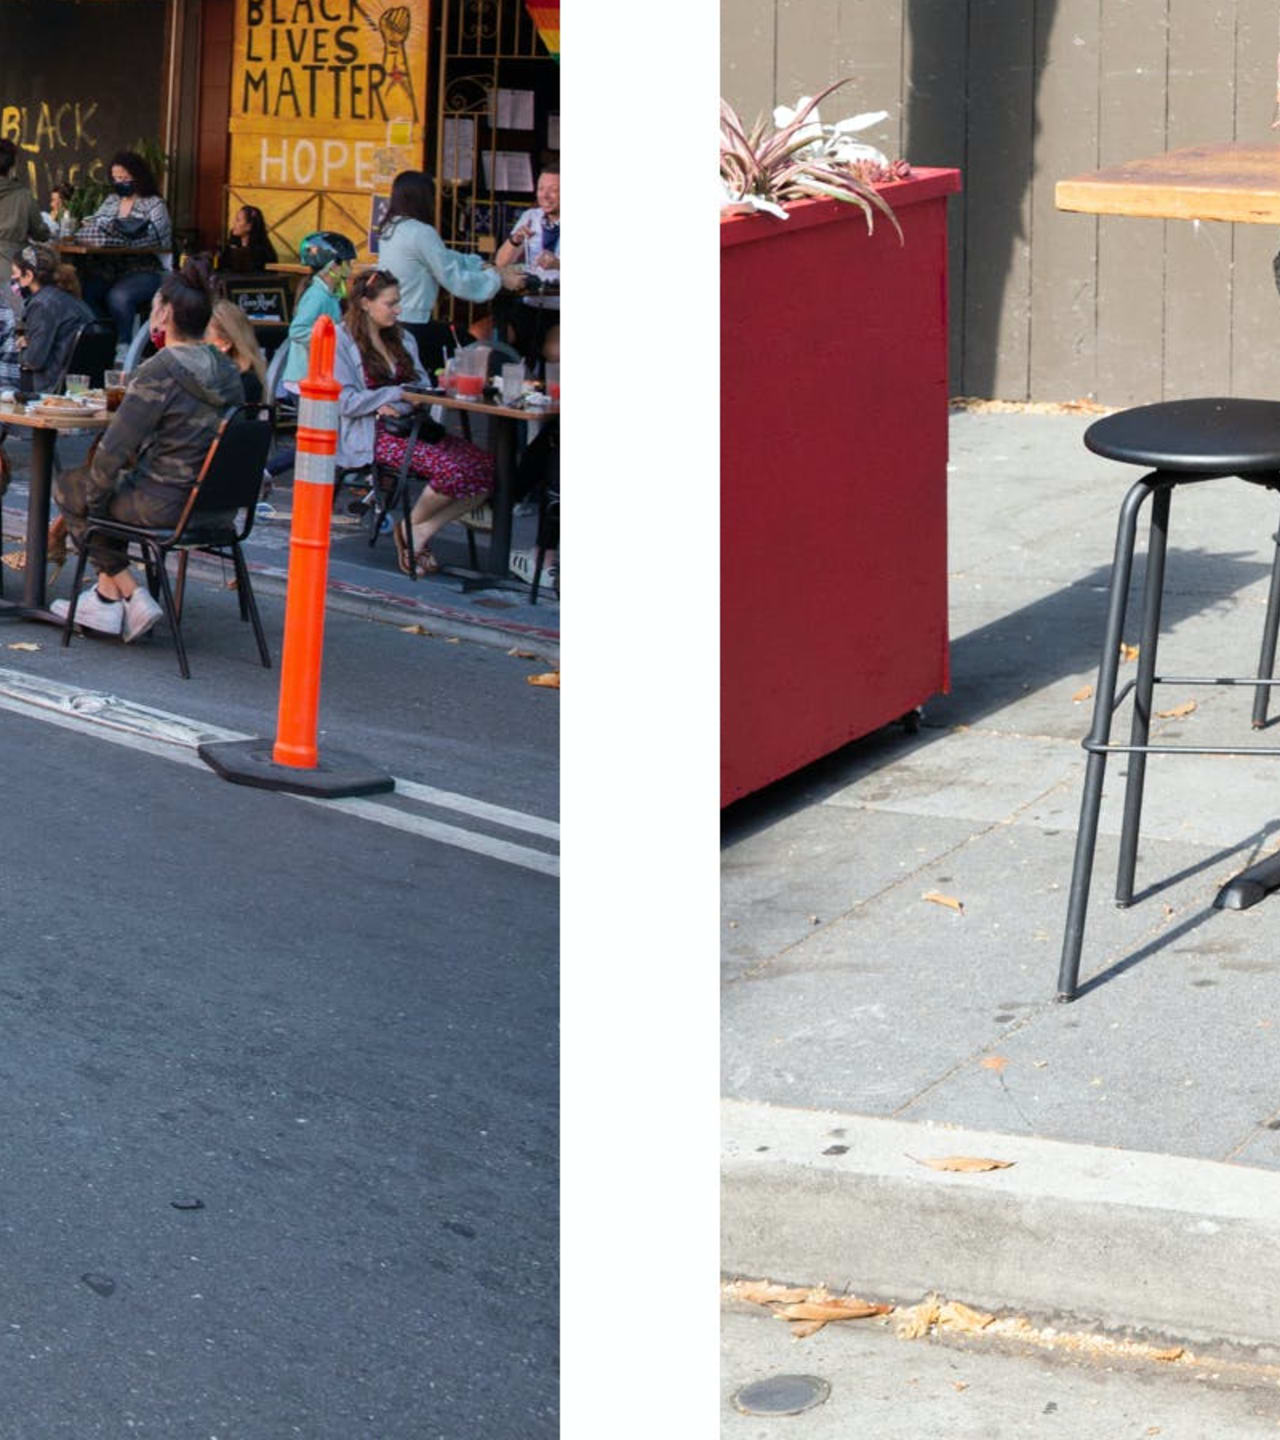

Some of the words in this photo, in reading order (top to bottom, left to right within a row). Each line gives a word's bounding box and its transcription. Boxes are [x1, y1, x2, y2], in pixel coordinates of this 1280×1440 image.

[246, 26, 360, 65] LIVES
[243, 63, 390, 122] MATTER
[1, 101, 98, 153] BLACK
[260, 138, 375, 189] HOPE
